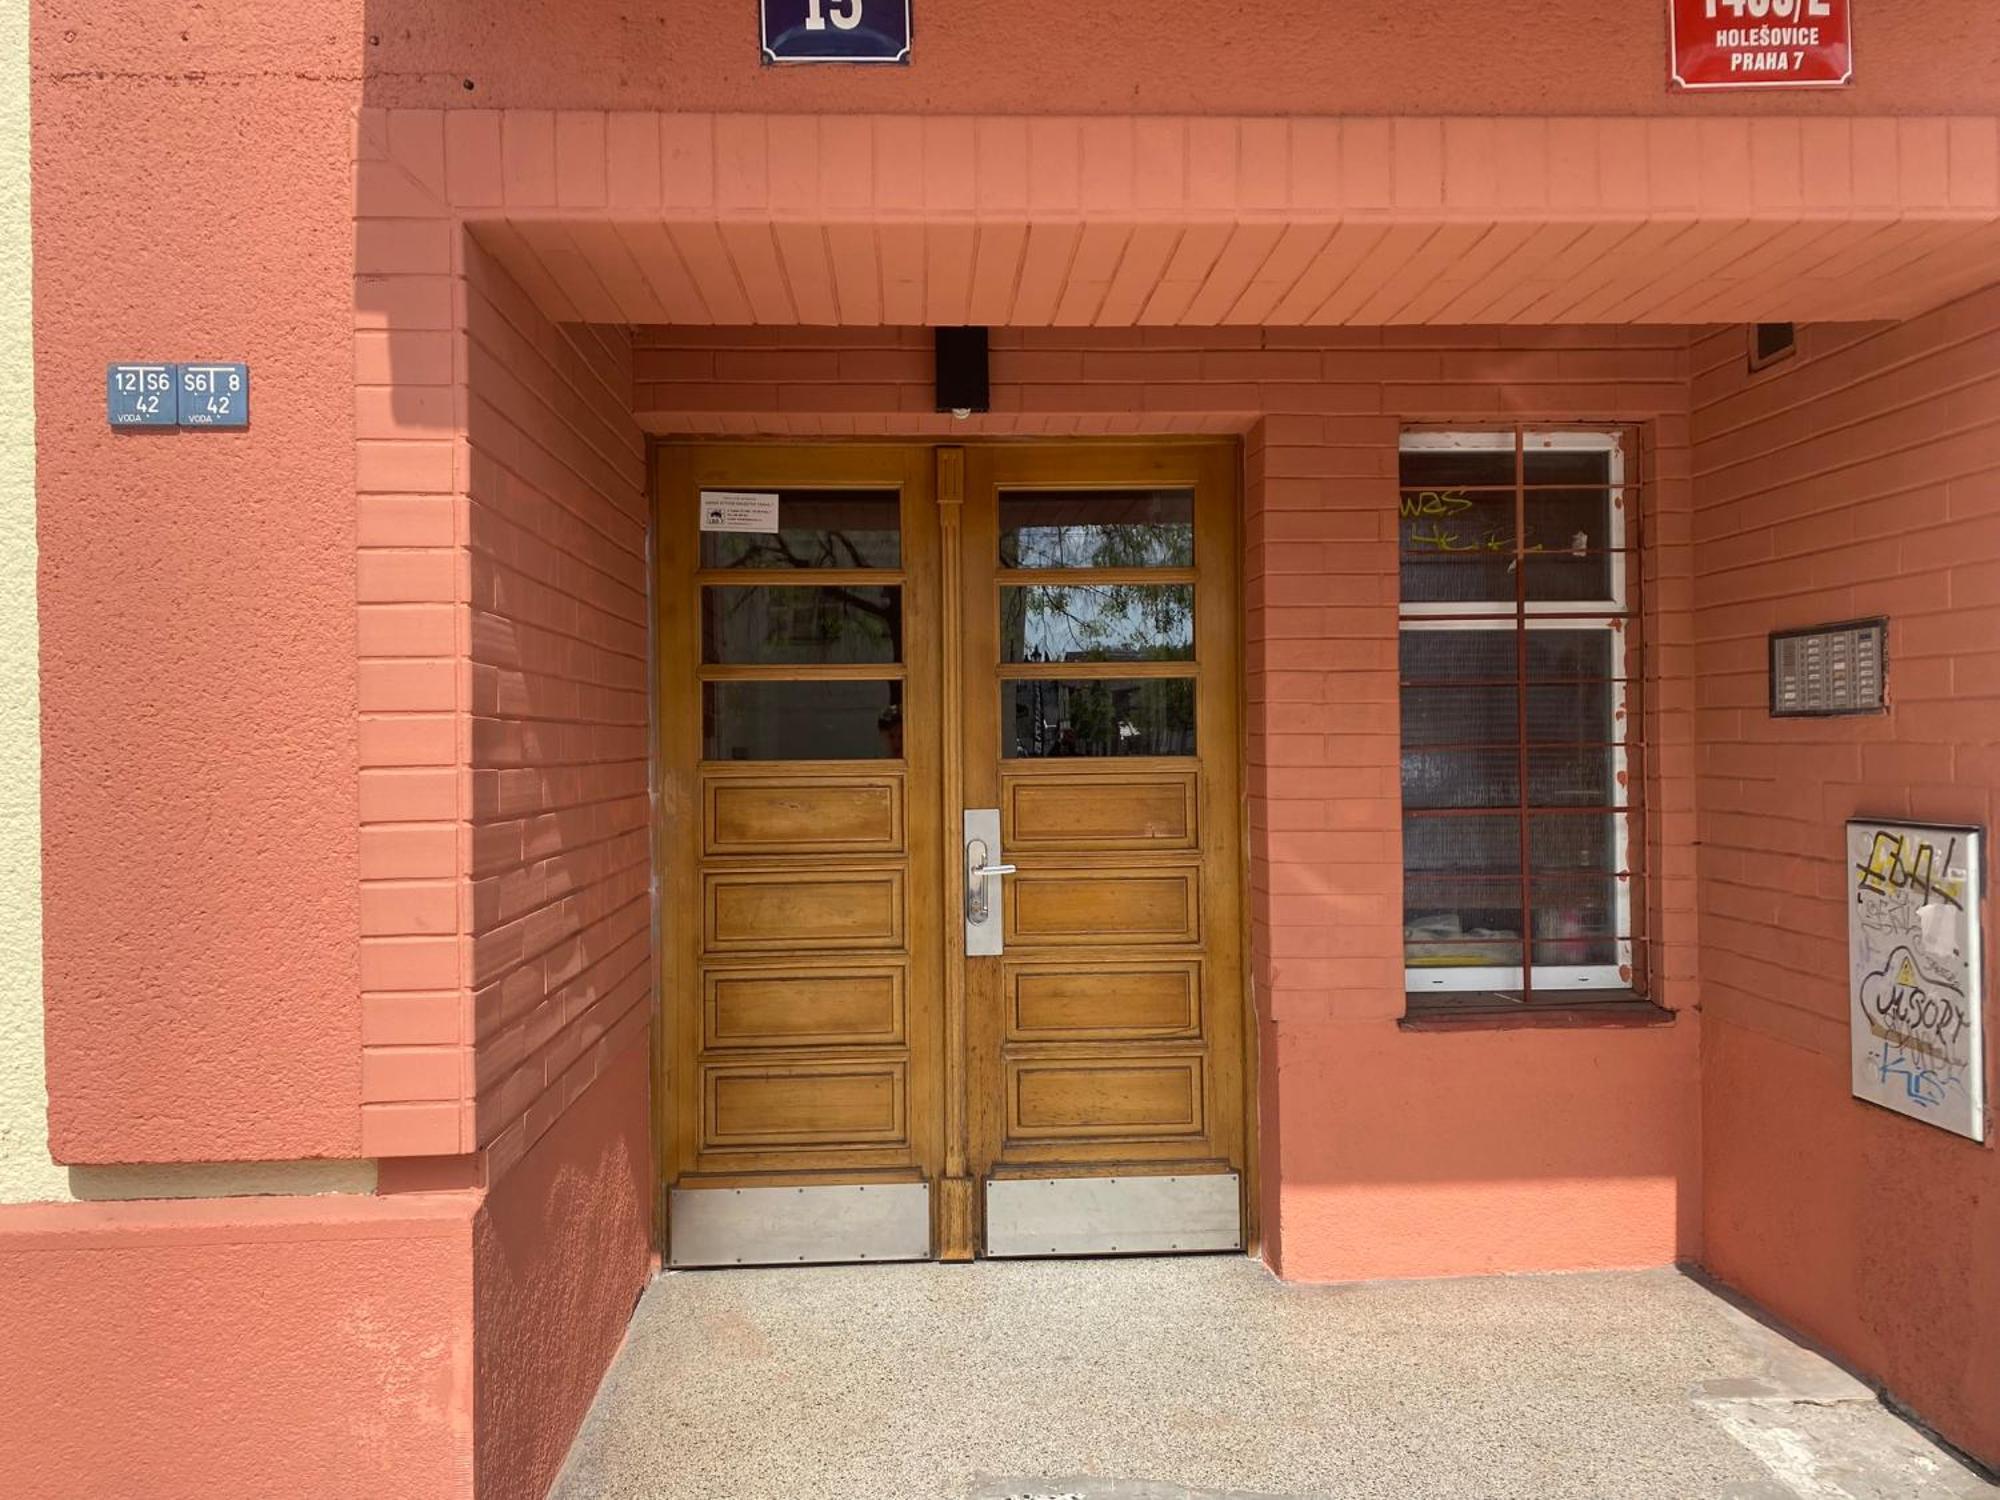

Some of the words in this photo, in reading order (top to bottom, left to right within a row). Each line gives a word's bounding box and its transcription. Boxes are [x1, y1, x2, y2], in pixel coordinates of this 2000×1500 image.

[1716, 24, 1819, 47] HOLEŠOVICE
[1731, 52, 1788, 71] PRAHA
[1793, 52, 1804, 70] 7
[115, 373, 136, 390] 12
[147, 373, 170, 390] S6
[184, 374, 207, 391] S6
[228, 374, 240, 391] 8
[136, 396, 159, 413] 42
[207, 397, 230, 414] 42
[117, 413, 142, 422] VODA
[188, 414, 213, 423] VODA
